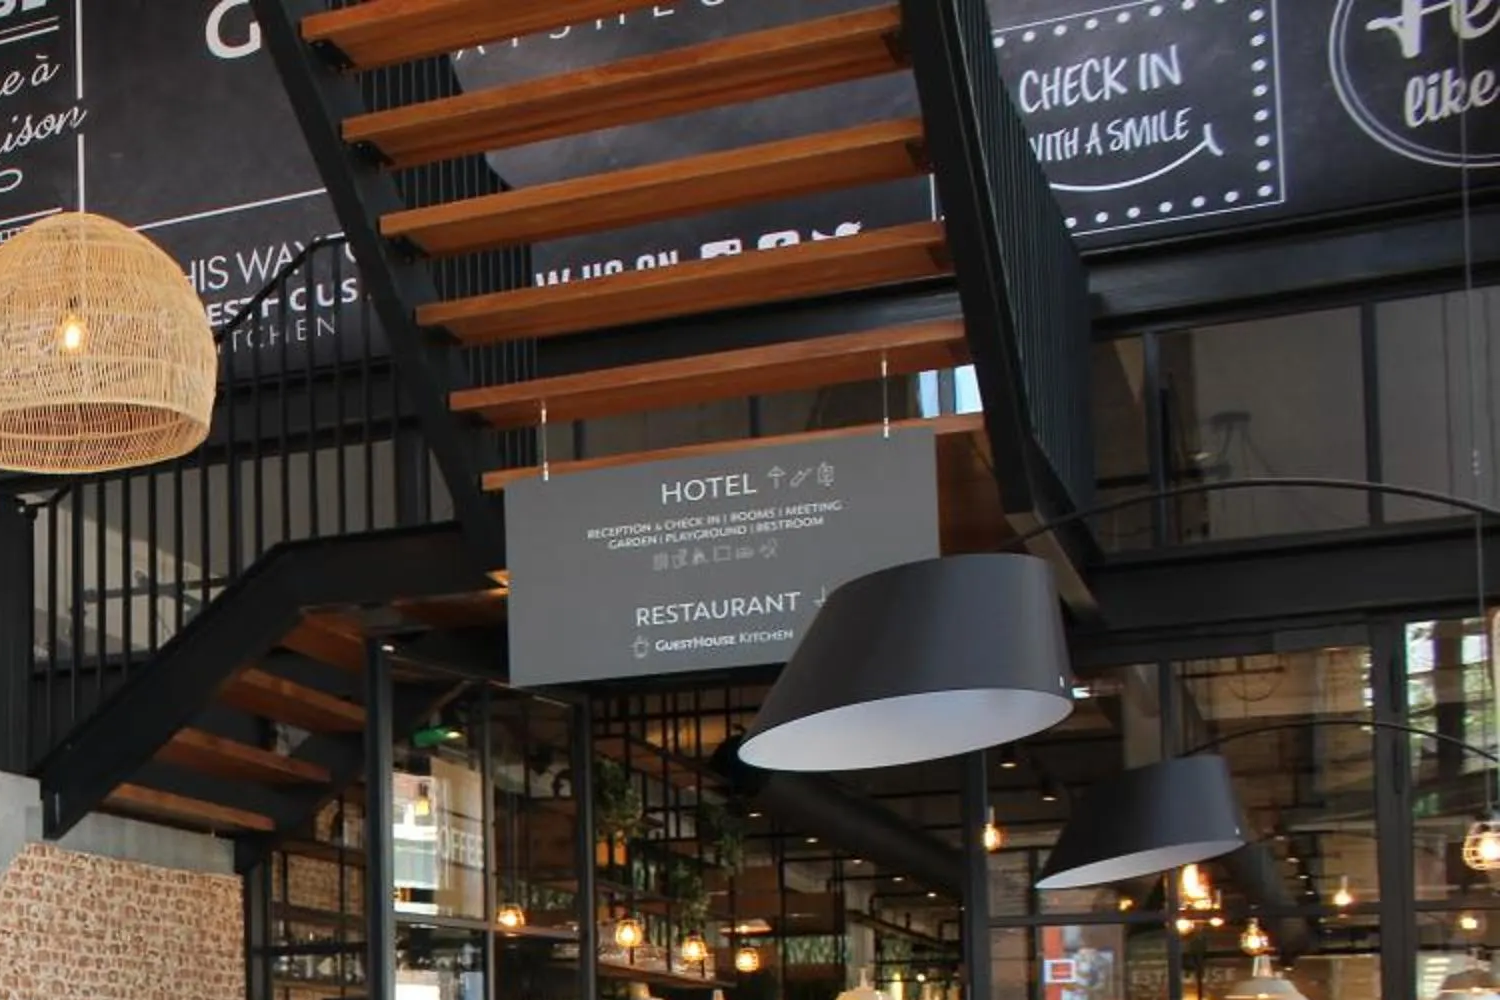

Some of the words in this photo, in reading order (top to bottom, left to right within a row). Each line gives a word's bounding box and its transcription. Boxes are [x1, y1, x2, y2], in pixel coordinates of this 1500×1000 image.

[30, 53, 62, 86] à
[1018, 55, 1128, 114] CHECK
[1138, 44, 1183, 92] IN
[1404, 68, 1500, 129] like
[1084, 122, 1104, 156] A
[1106, 106, 1194, 153] SMILE
[184, 255, 230, 293] HIS
[660, 472, 758, 505] HOTEL
[587, 521, 651, 539] RECEPTION
[664, 516, 703, 531] CHECK
[706, 514, 721, 526] IN
[730, 506, 776, 522] ROOMS
[784, 499, 844, 517] MEETING
[607, 534, 658, 550] GARDEN
[665, 525, 748, 544] PLAYGROUND
[756, 516, 825, 533] RESTROOM
[635, 590, 801, 628] RESTAURANT
[738, 628, 794, 645] KITCHEN
